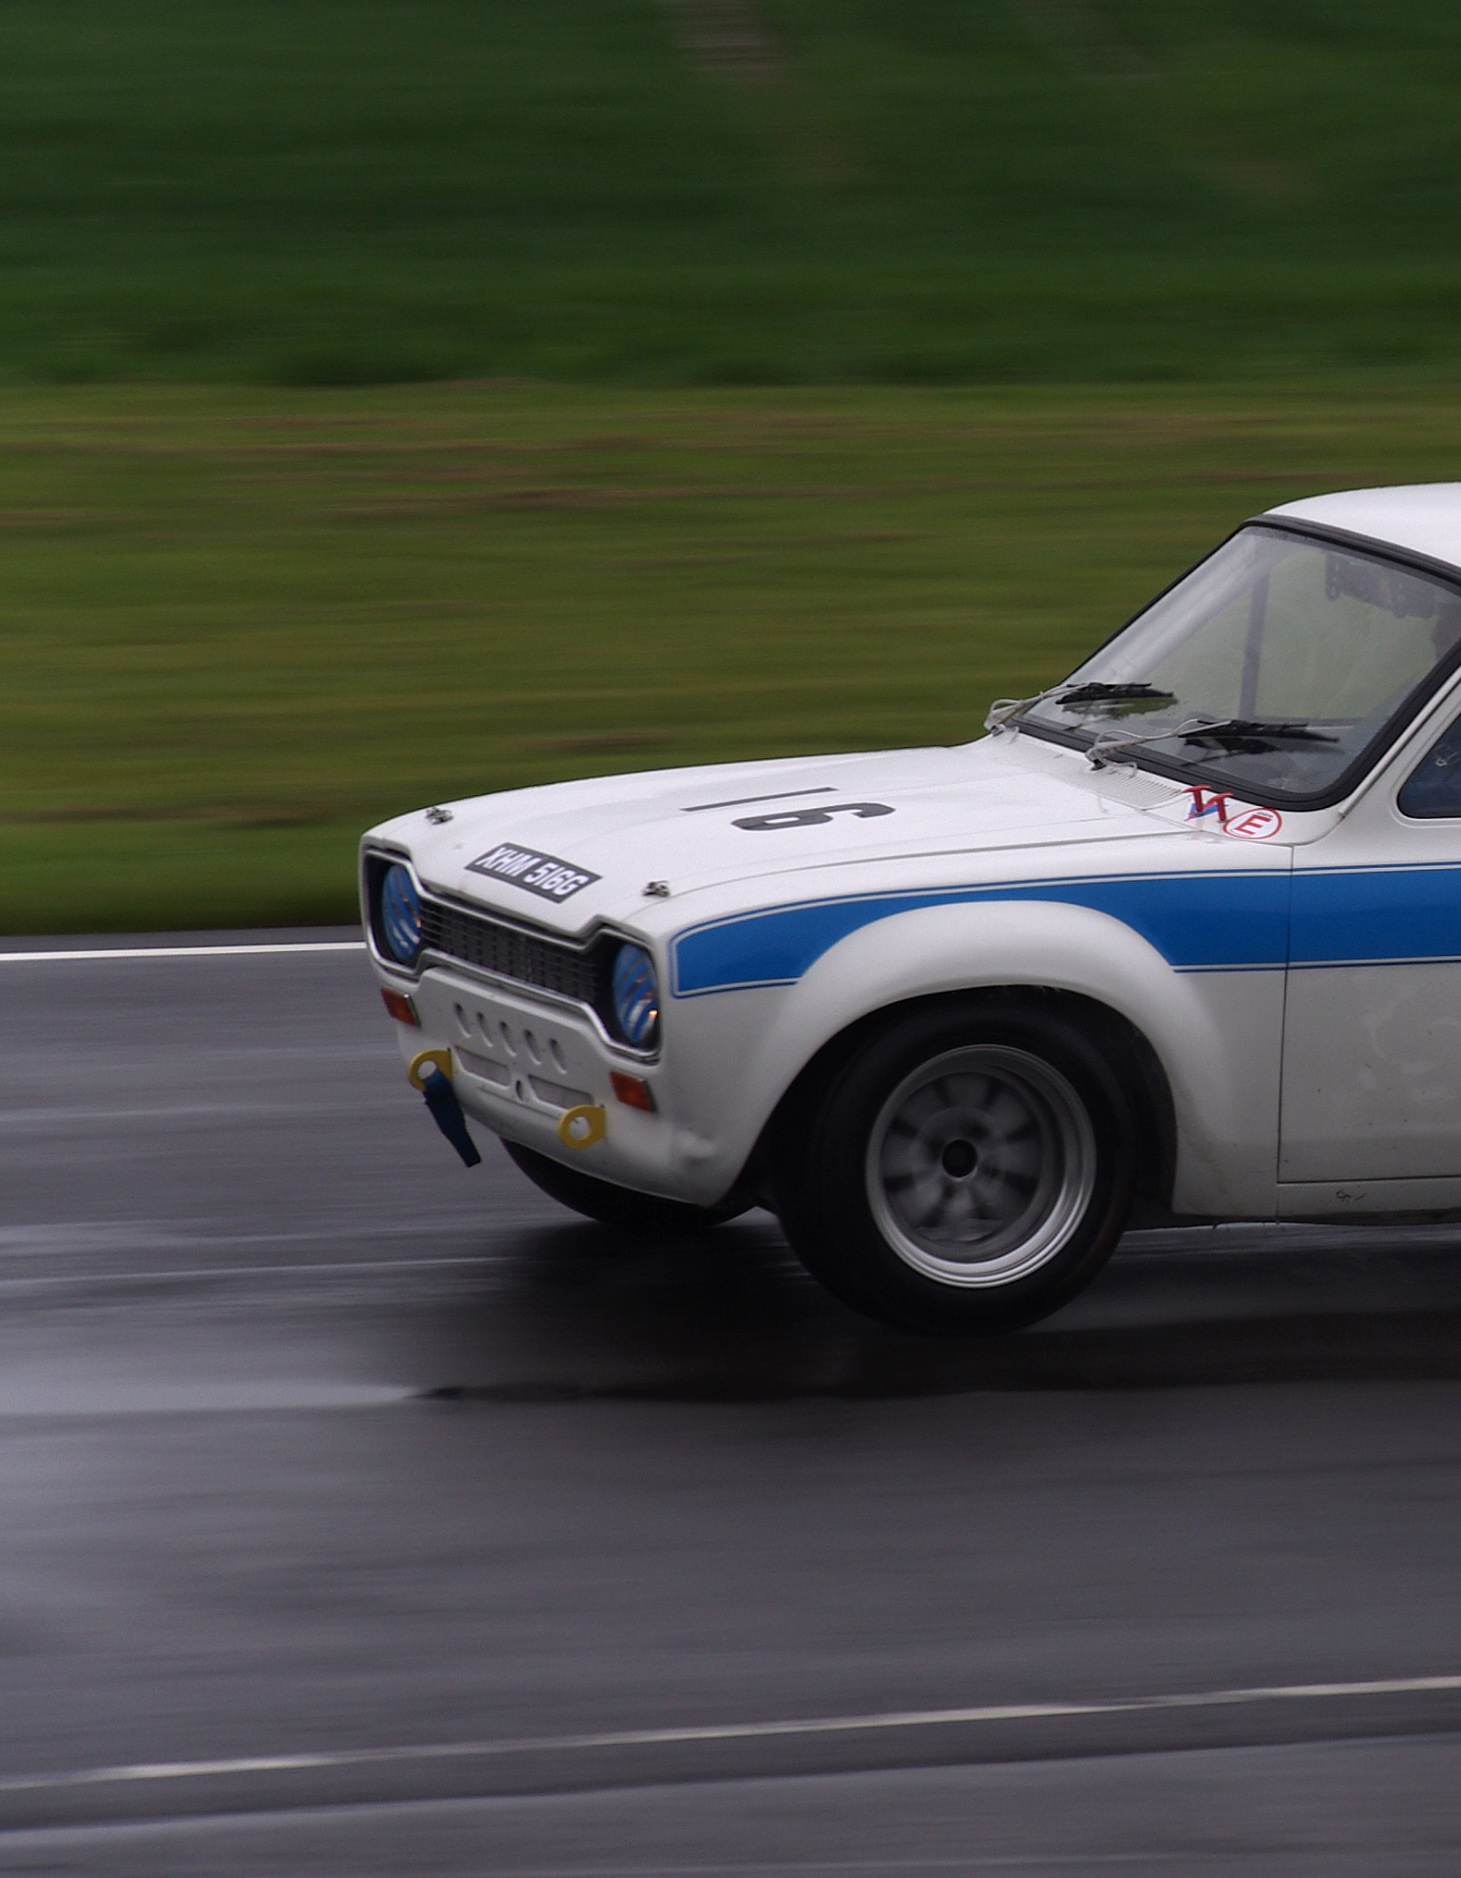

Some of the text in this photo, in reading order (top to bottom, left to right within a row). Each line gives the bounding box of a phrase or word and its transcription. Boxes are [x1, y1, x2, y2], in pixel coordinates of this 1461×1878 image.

[679, 786, 896, 831] 16
[1234, 813, 1272, 835] E
[474, 847, 590, 895] XHM 516G
